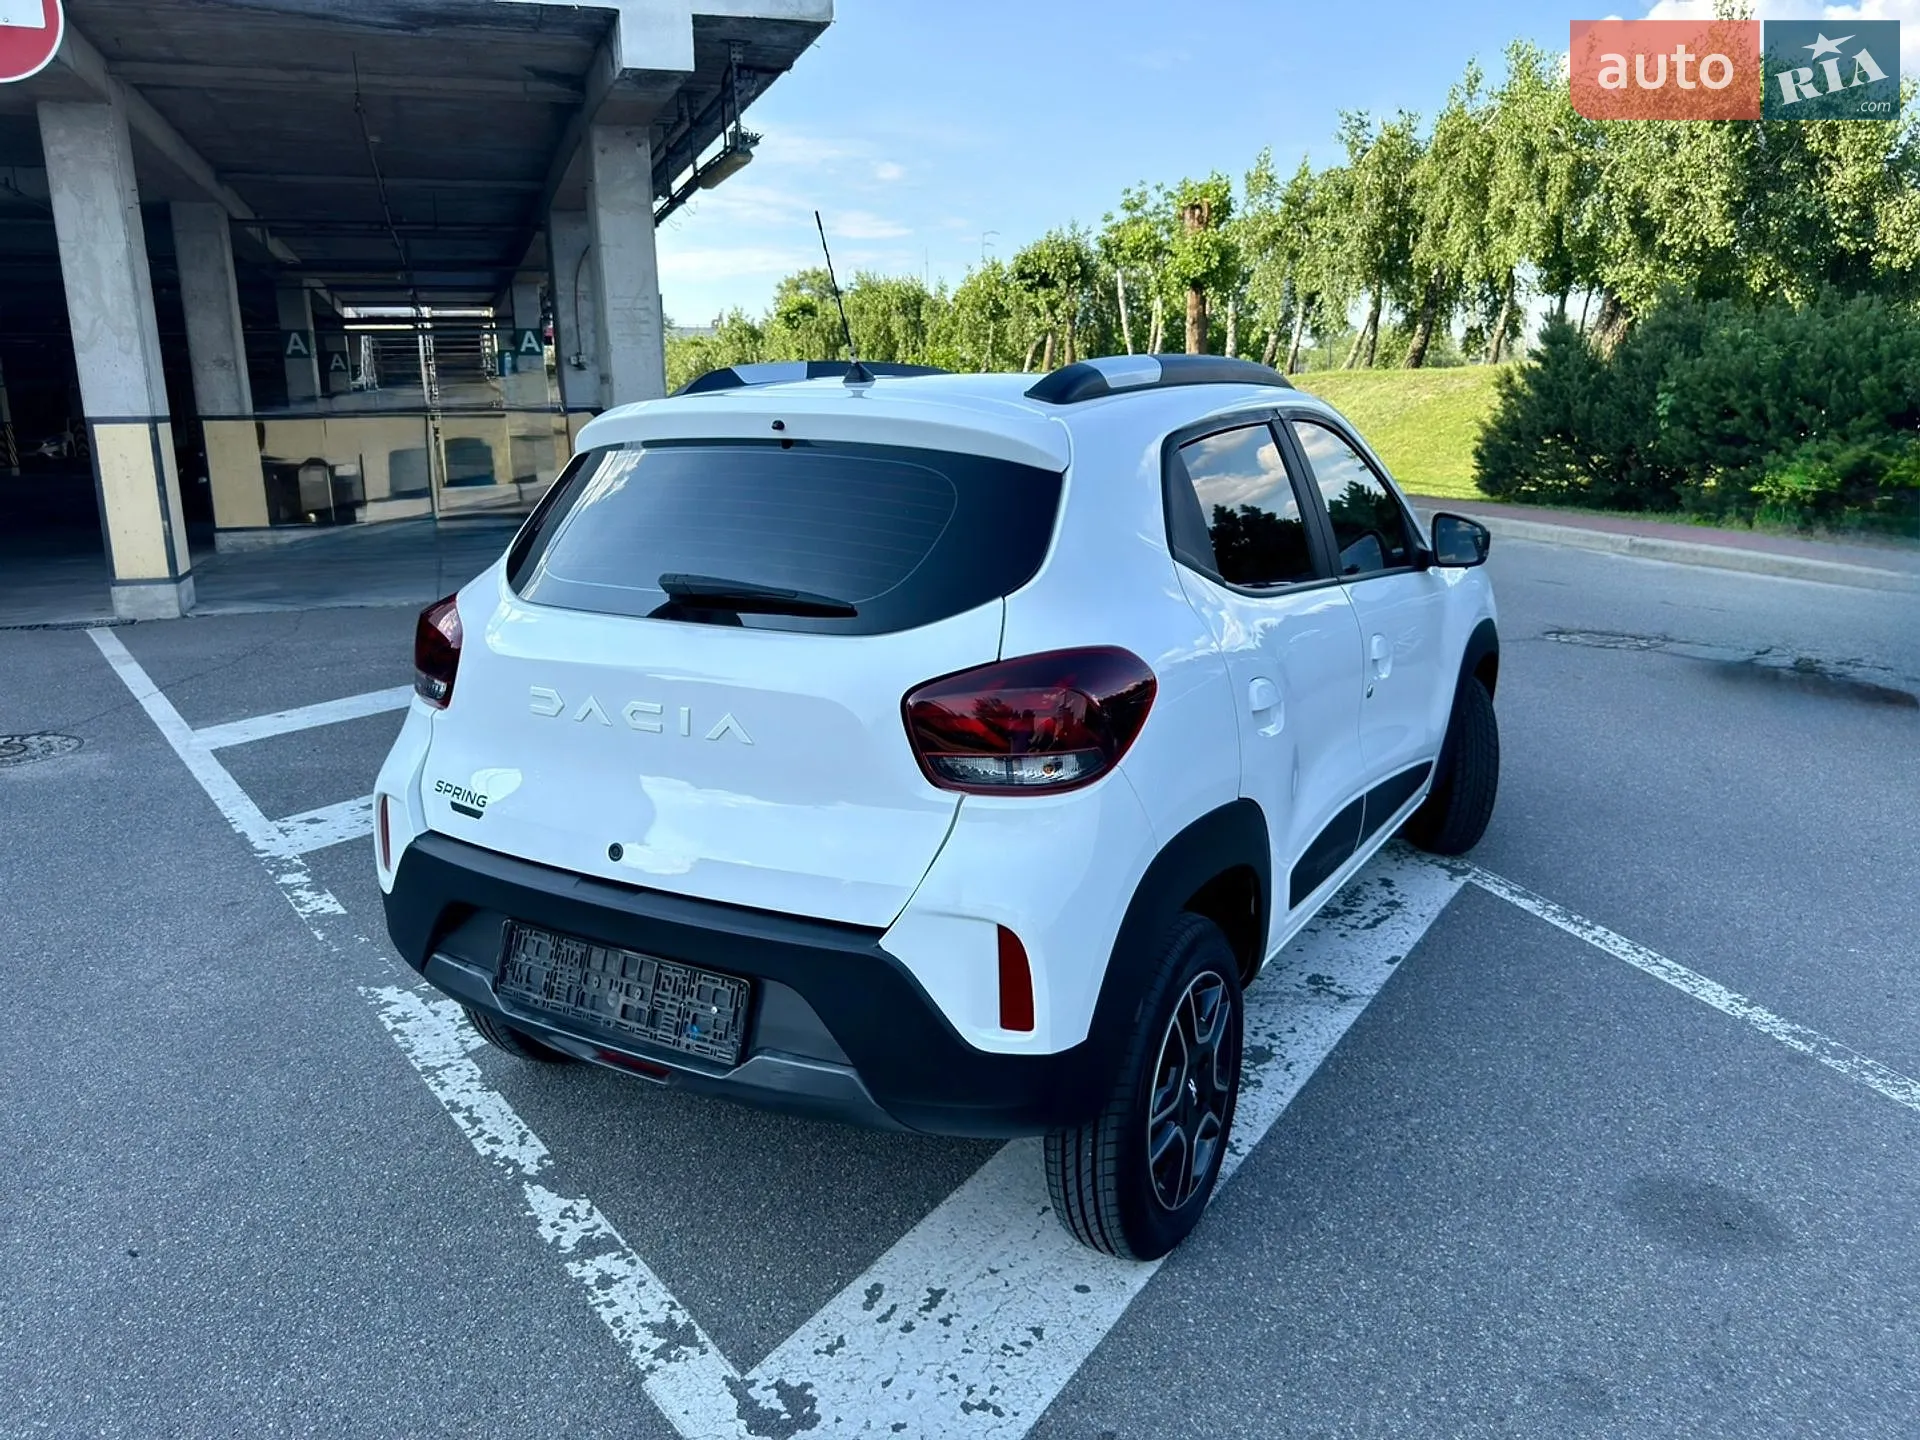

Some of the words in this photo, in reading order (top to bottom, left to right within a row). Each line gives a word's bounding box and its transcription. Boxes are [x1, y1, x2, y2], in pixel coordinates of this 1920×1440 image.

[286, 332, 309, 355] A
[521, 330, 541, 352] A
[330, 353, 347, 370] A
[529, 685, 754, 746] DACIA
[434, 779, 489, 808] SPRING
